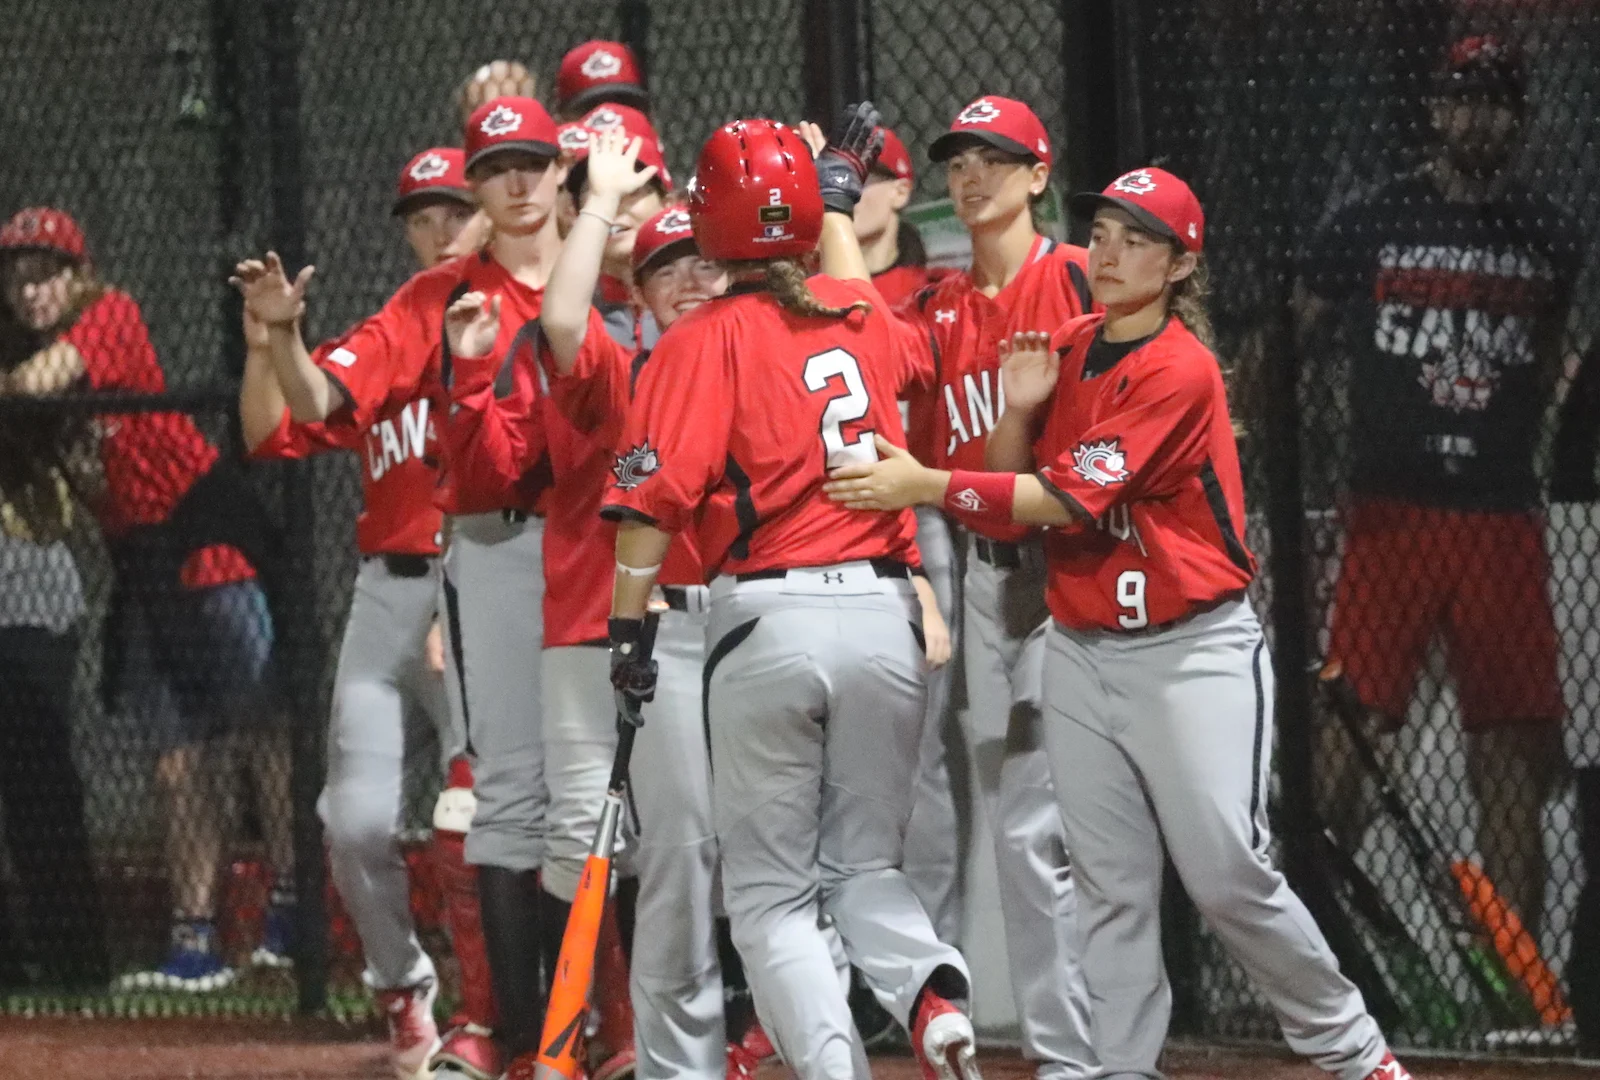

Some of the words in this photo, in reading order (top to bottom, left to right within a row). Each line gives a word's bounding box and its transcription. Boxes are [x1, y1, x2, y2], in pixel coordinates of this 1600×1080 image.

[769, 187, 782, 206] 2
[801, 346, 879, 474] 2
[1116, 570, 1149, 629] 9
